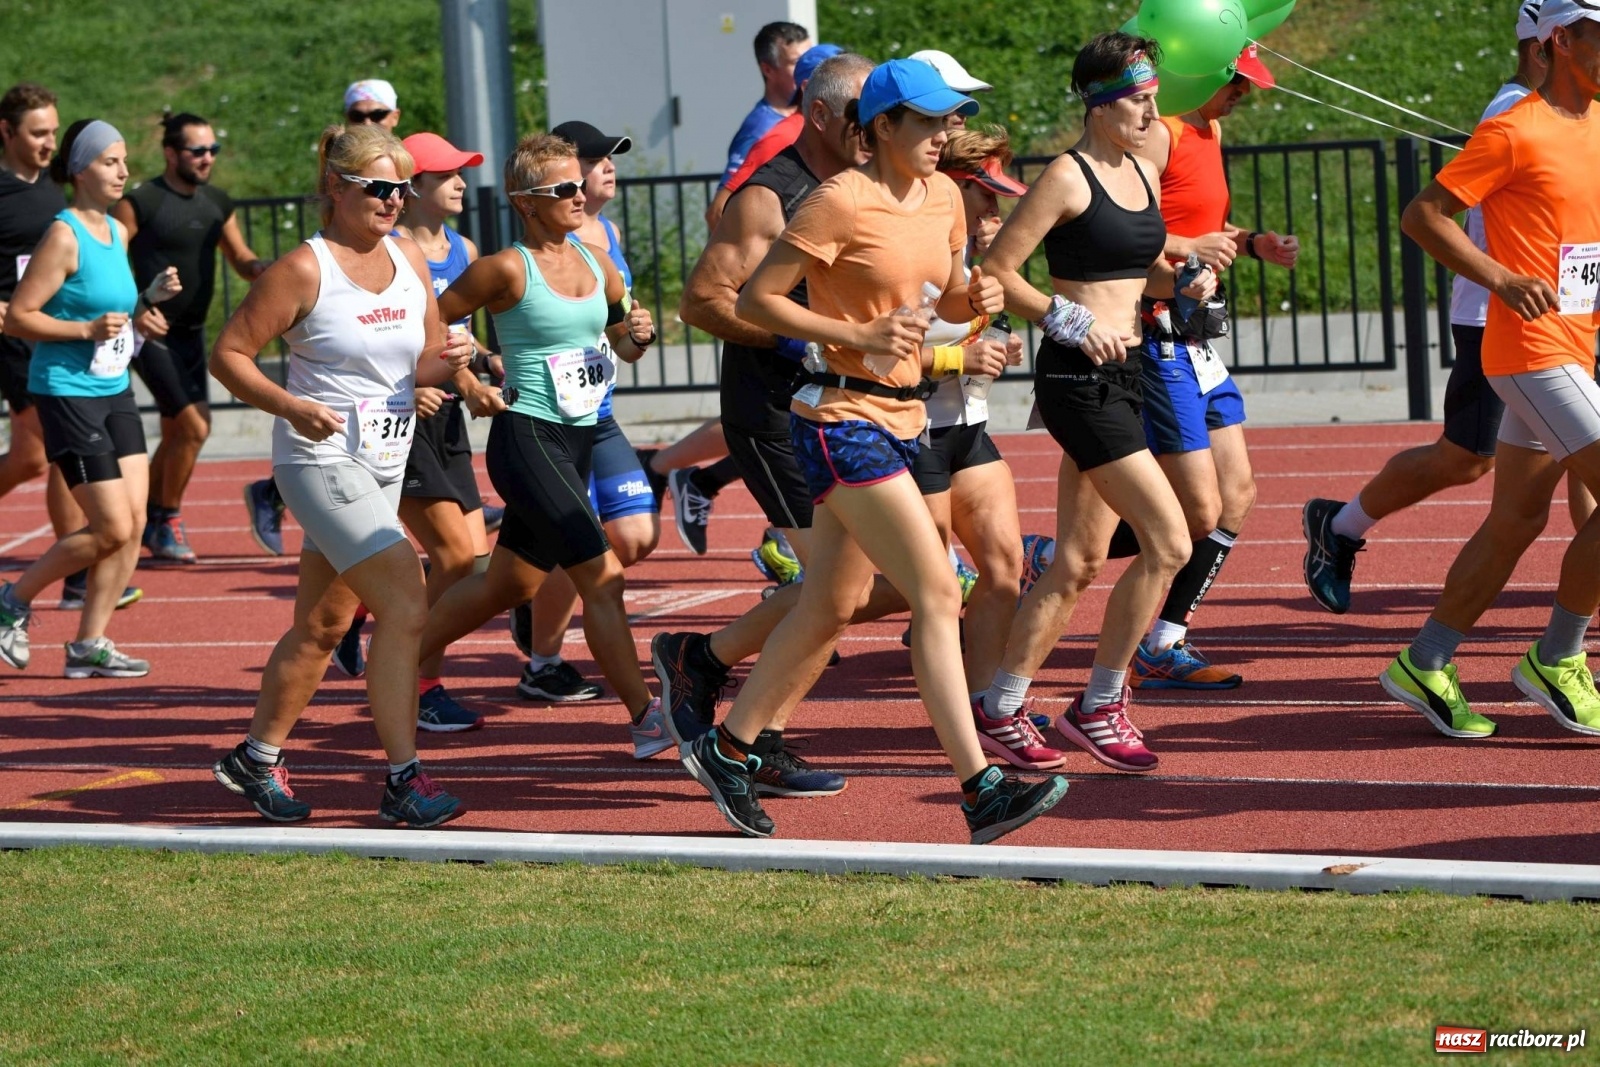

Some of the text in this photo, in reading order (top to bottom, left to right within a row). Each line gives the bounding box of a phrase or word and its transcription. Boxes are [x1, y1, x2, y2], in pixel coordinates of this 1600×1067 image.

[357, 307, 406, 325] RAFAKO
[577, 363, 604, 388] 388
[381, 416, 411, 439] 312
